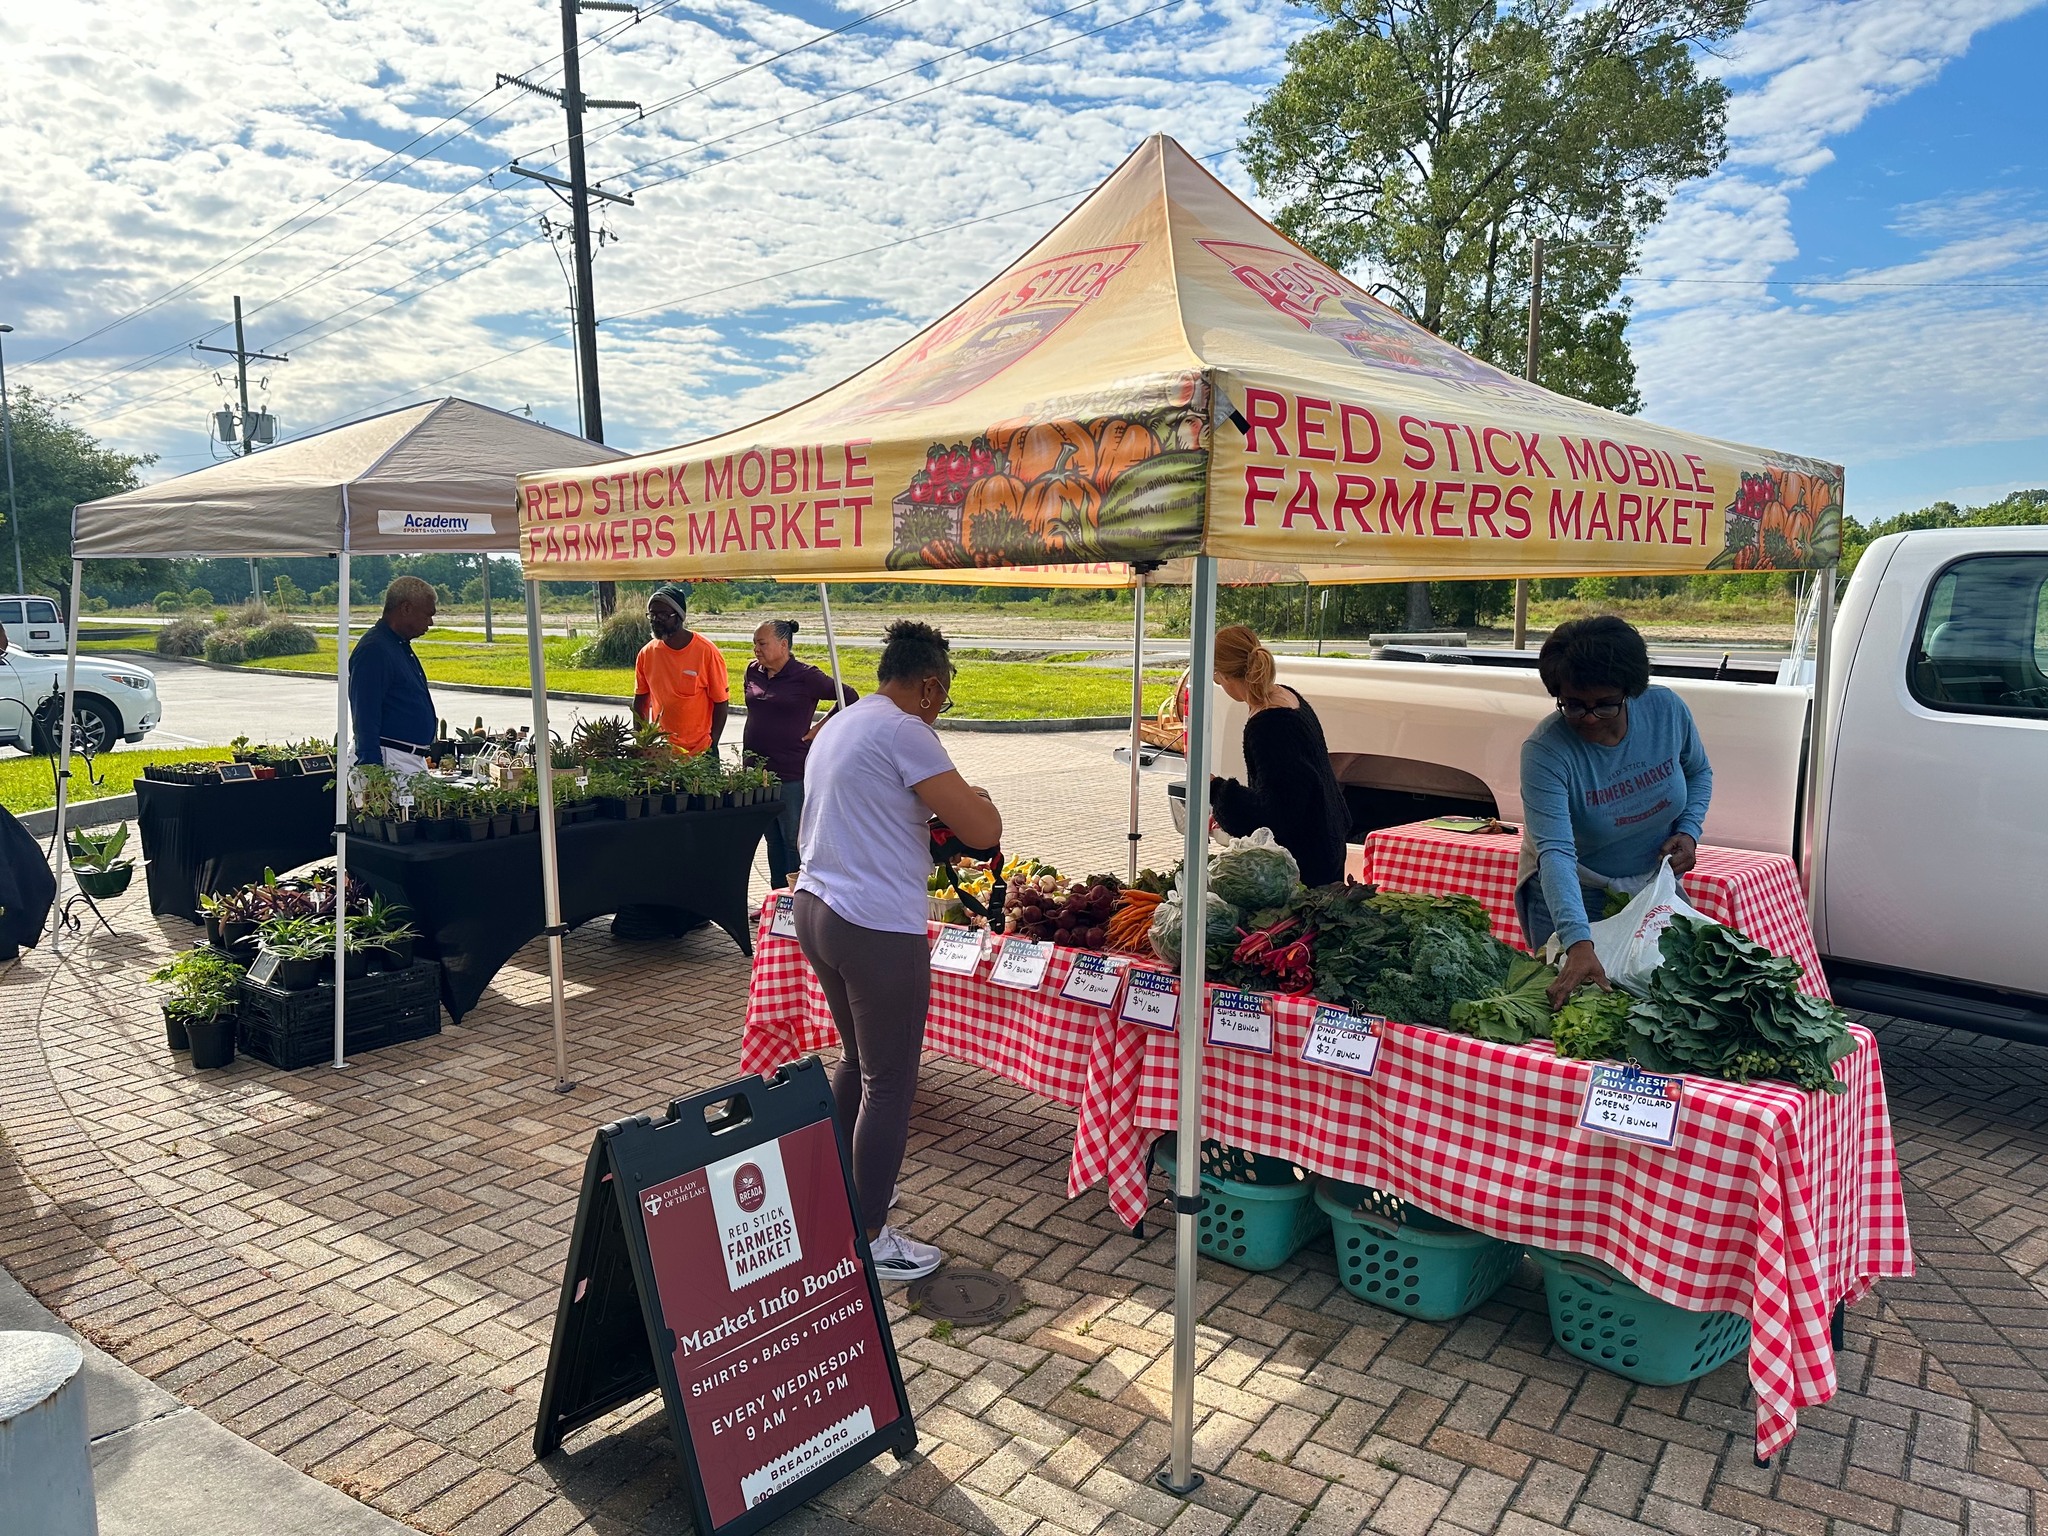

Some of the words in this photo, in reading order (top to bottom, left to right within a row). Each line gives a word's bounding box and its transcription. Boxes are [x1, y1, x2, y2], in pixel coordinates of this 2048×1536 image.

[1244, 386, 1383, 464] RED
[1399, 415, 1556, 479] STICK
[1558, 435, 1716, 494] MOBILE
[526, 479, 584, 522] RED
[592, 463, 691, 516] STICK
[704, 437, 875, 504] MOBILE
[1242, 465, 1535, 540] FARMERS
[1548, 489, 1715, 546] MARKET
[404, 513, 469, 531] Academy
[528, 514, 677, 563] FARMERS
[688, 495, 875, 556] MARKET
[1622, 761, 1647, 772] STICK
[1585, 779, 1634, 807] FARMERS
[1633, 758, 1675, 791] MARKET
[961, 936, 980, 944] LOCAL
[1025, 942, 1045, 951] FRESH
[1008, 954, 1027, 963] BEETS
[1023, 950, 1043, 958] LOCAL
[1095, 965, 1118, 975] LOCAL
[1098, 958, 1120, 968] FRESH
[1078, 970, 1103, 980] CARROTS
[1136, 971, 1150, 980] BUY
[1152, 973, 1174, 984] FRESH
[1134, 988, 1160, 998] SPINACH
[1135, 979, 1149, 988] BUY
[1150, 982, 1174, 992] LOCAL
[1219, 999, 1237, 1008] BUY
[1239, 1003, 1265, 1012] LOCAL
[1220, 991, 1238, 999] BUY
[1239, 995, 1264, 1003] FRESH
[1217, 1009, 1237, 1017] SWISS
[1239, 1012, 1261, 1020] CHARD
[1324, 1009, 1344, 1019] BUY
[1322, 1018, 1342, 1027] BUY
[1343, 1022, 1373, 1034] LOCAL
[1316, 1034, 1338, 1045] KALE
[1601, 1079, 1627, 1090] BUY
[1628, 1084, 1668, 1098] LOCAL
[1630, 1075, 1668, 1088] RESH
[1594, 1098, 1630, 1111] GREENS
[663, 1188, 679, 1199] OUR
[679, 1181, 697, 1194] LADY
[665, 1200, 674, 1208] OF
[675, 1195, 689, 1204] THE
[689, 1186, 706, 1199] LAKE
[739, 1185, 763, 1203] BREADA
[728, 1222, 749, 1239] RED
[754, 1206, 785, 1228] STICK
[727, 1219, 792, 1260] FARMERS
[735, 1237, 792, 1277] MARKET
[680, 1306, 757, 1357] Market
[758, 1287, 799, 1319] Info
[802, 1257, 856, 1297] Booth
[691, 1360, 749, 1397] SHIRTS
[762, 1333, 799, 1361] BAGS
[811, 1299, 864, 1335] TOKENS
[711, 1395, 766, 1435] EVERY
[772, 1340, 865, 1401] WEDNESDAY
[746, 1426, 756, 1441] 9
[763, 1409, 786, 1433] AM
[804, 1389, 822, 1408] 12
[826, 1373, 849, 1396] PM
[770, 1428, 849, 1481] BREADA.ORG
[776, 1430, 870, 1491] @REDSTICKFARMERSMARKET
